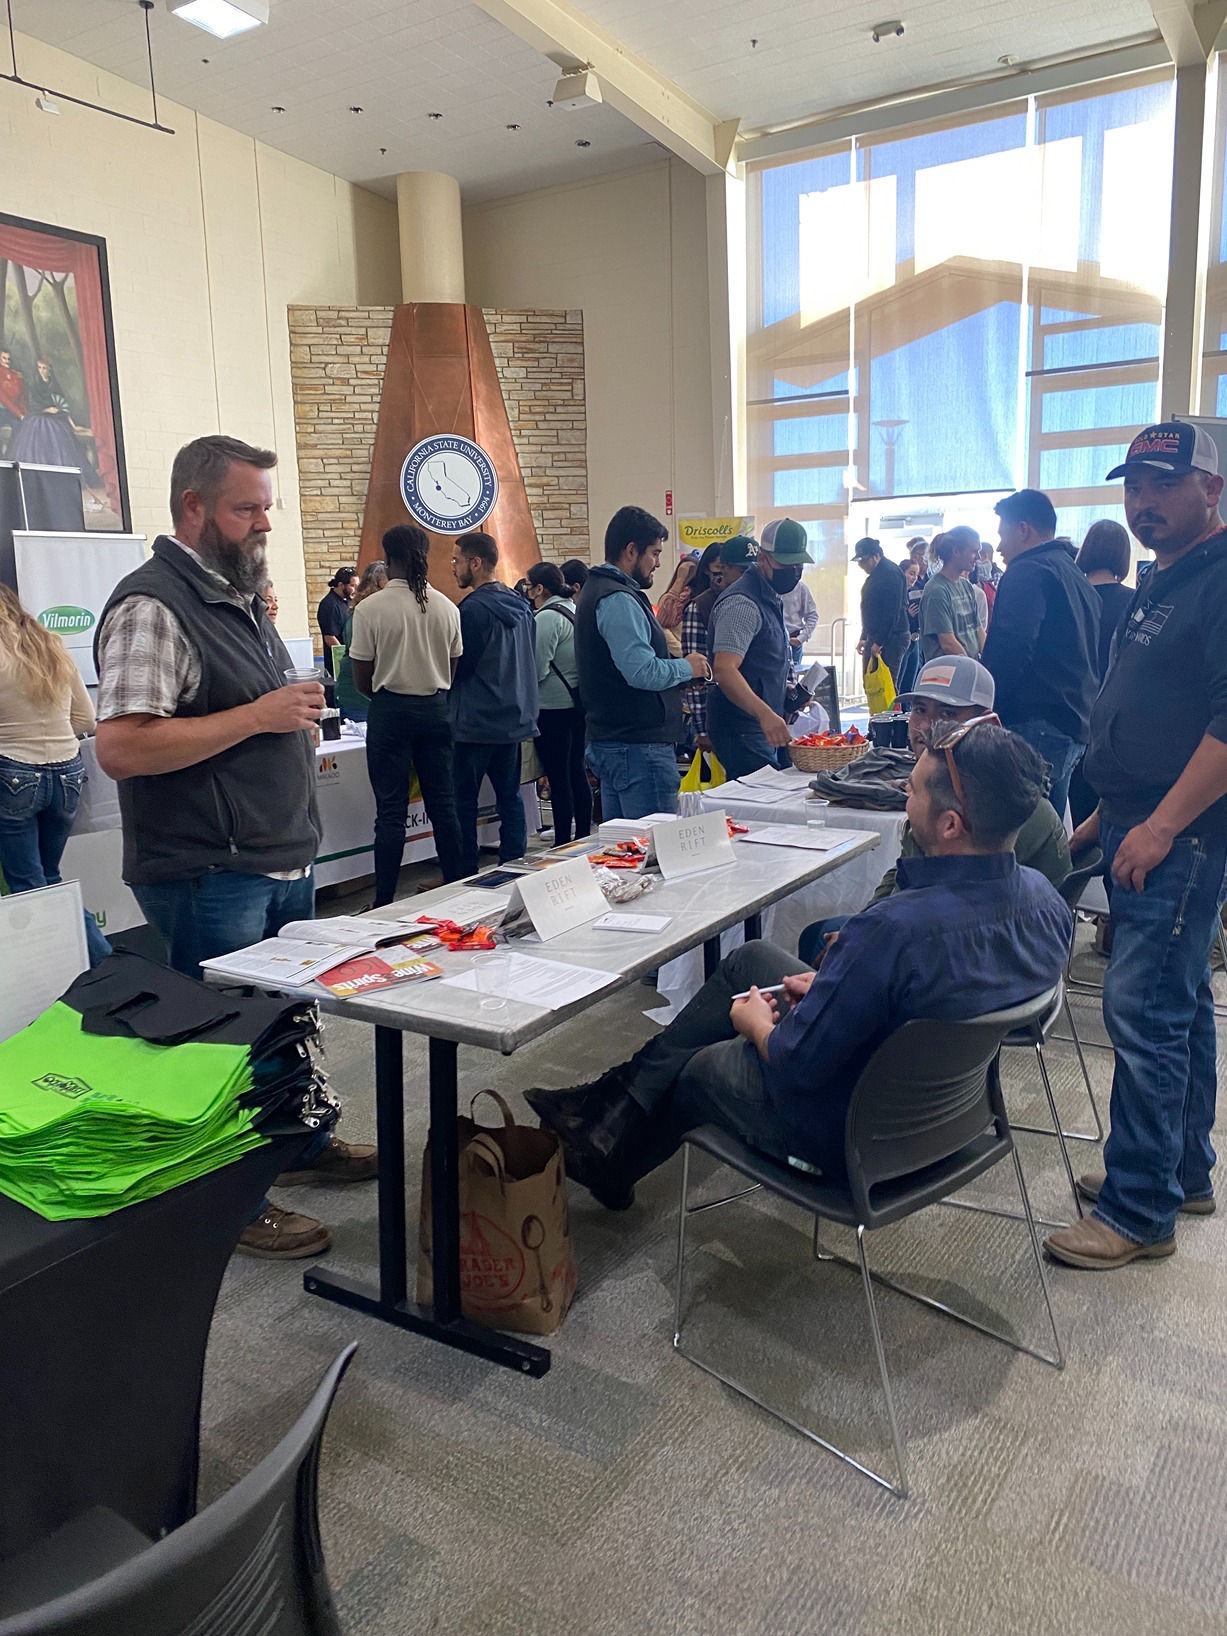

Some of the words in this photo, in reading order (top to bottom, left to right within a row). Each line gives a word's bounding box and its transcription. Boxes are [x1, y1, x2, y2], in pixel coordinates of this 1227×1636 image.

[1130, 438, 1180, 457] GMC
[406, 445, 434, 492] CALIFORNIA
[433, 440, 459, 451] STATE
[460, 444, 492, 487] UNIVERSITY
[478, 497, 490, 512] 1994
[412, 502, 457, 528] MONTEREY
[458, 516, 473, 528] BAY
[684, 524, 733, 536] Driscoll's
[42, 612, 91, 628] Vilmorin
[678, 825, 705, 840] EDEN
[680, 837, 707, 852] RIFT
[545, 874, 573, 893] EDEN
[550, 888, 578, 906] RIFT
[391, 962, 435, 977] Wine
[333, 973, 387, 991] Spirits
[460, 1258, 517, 1273] RADER
